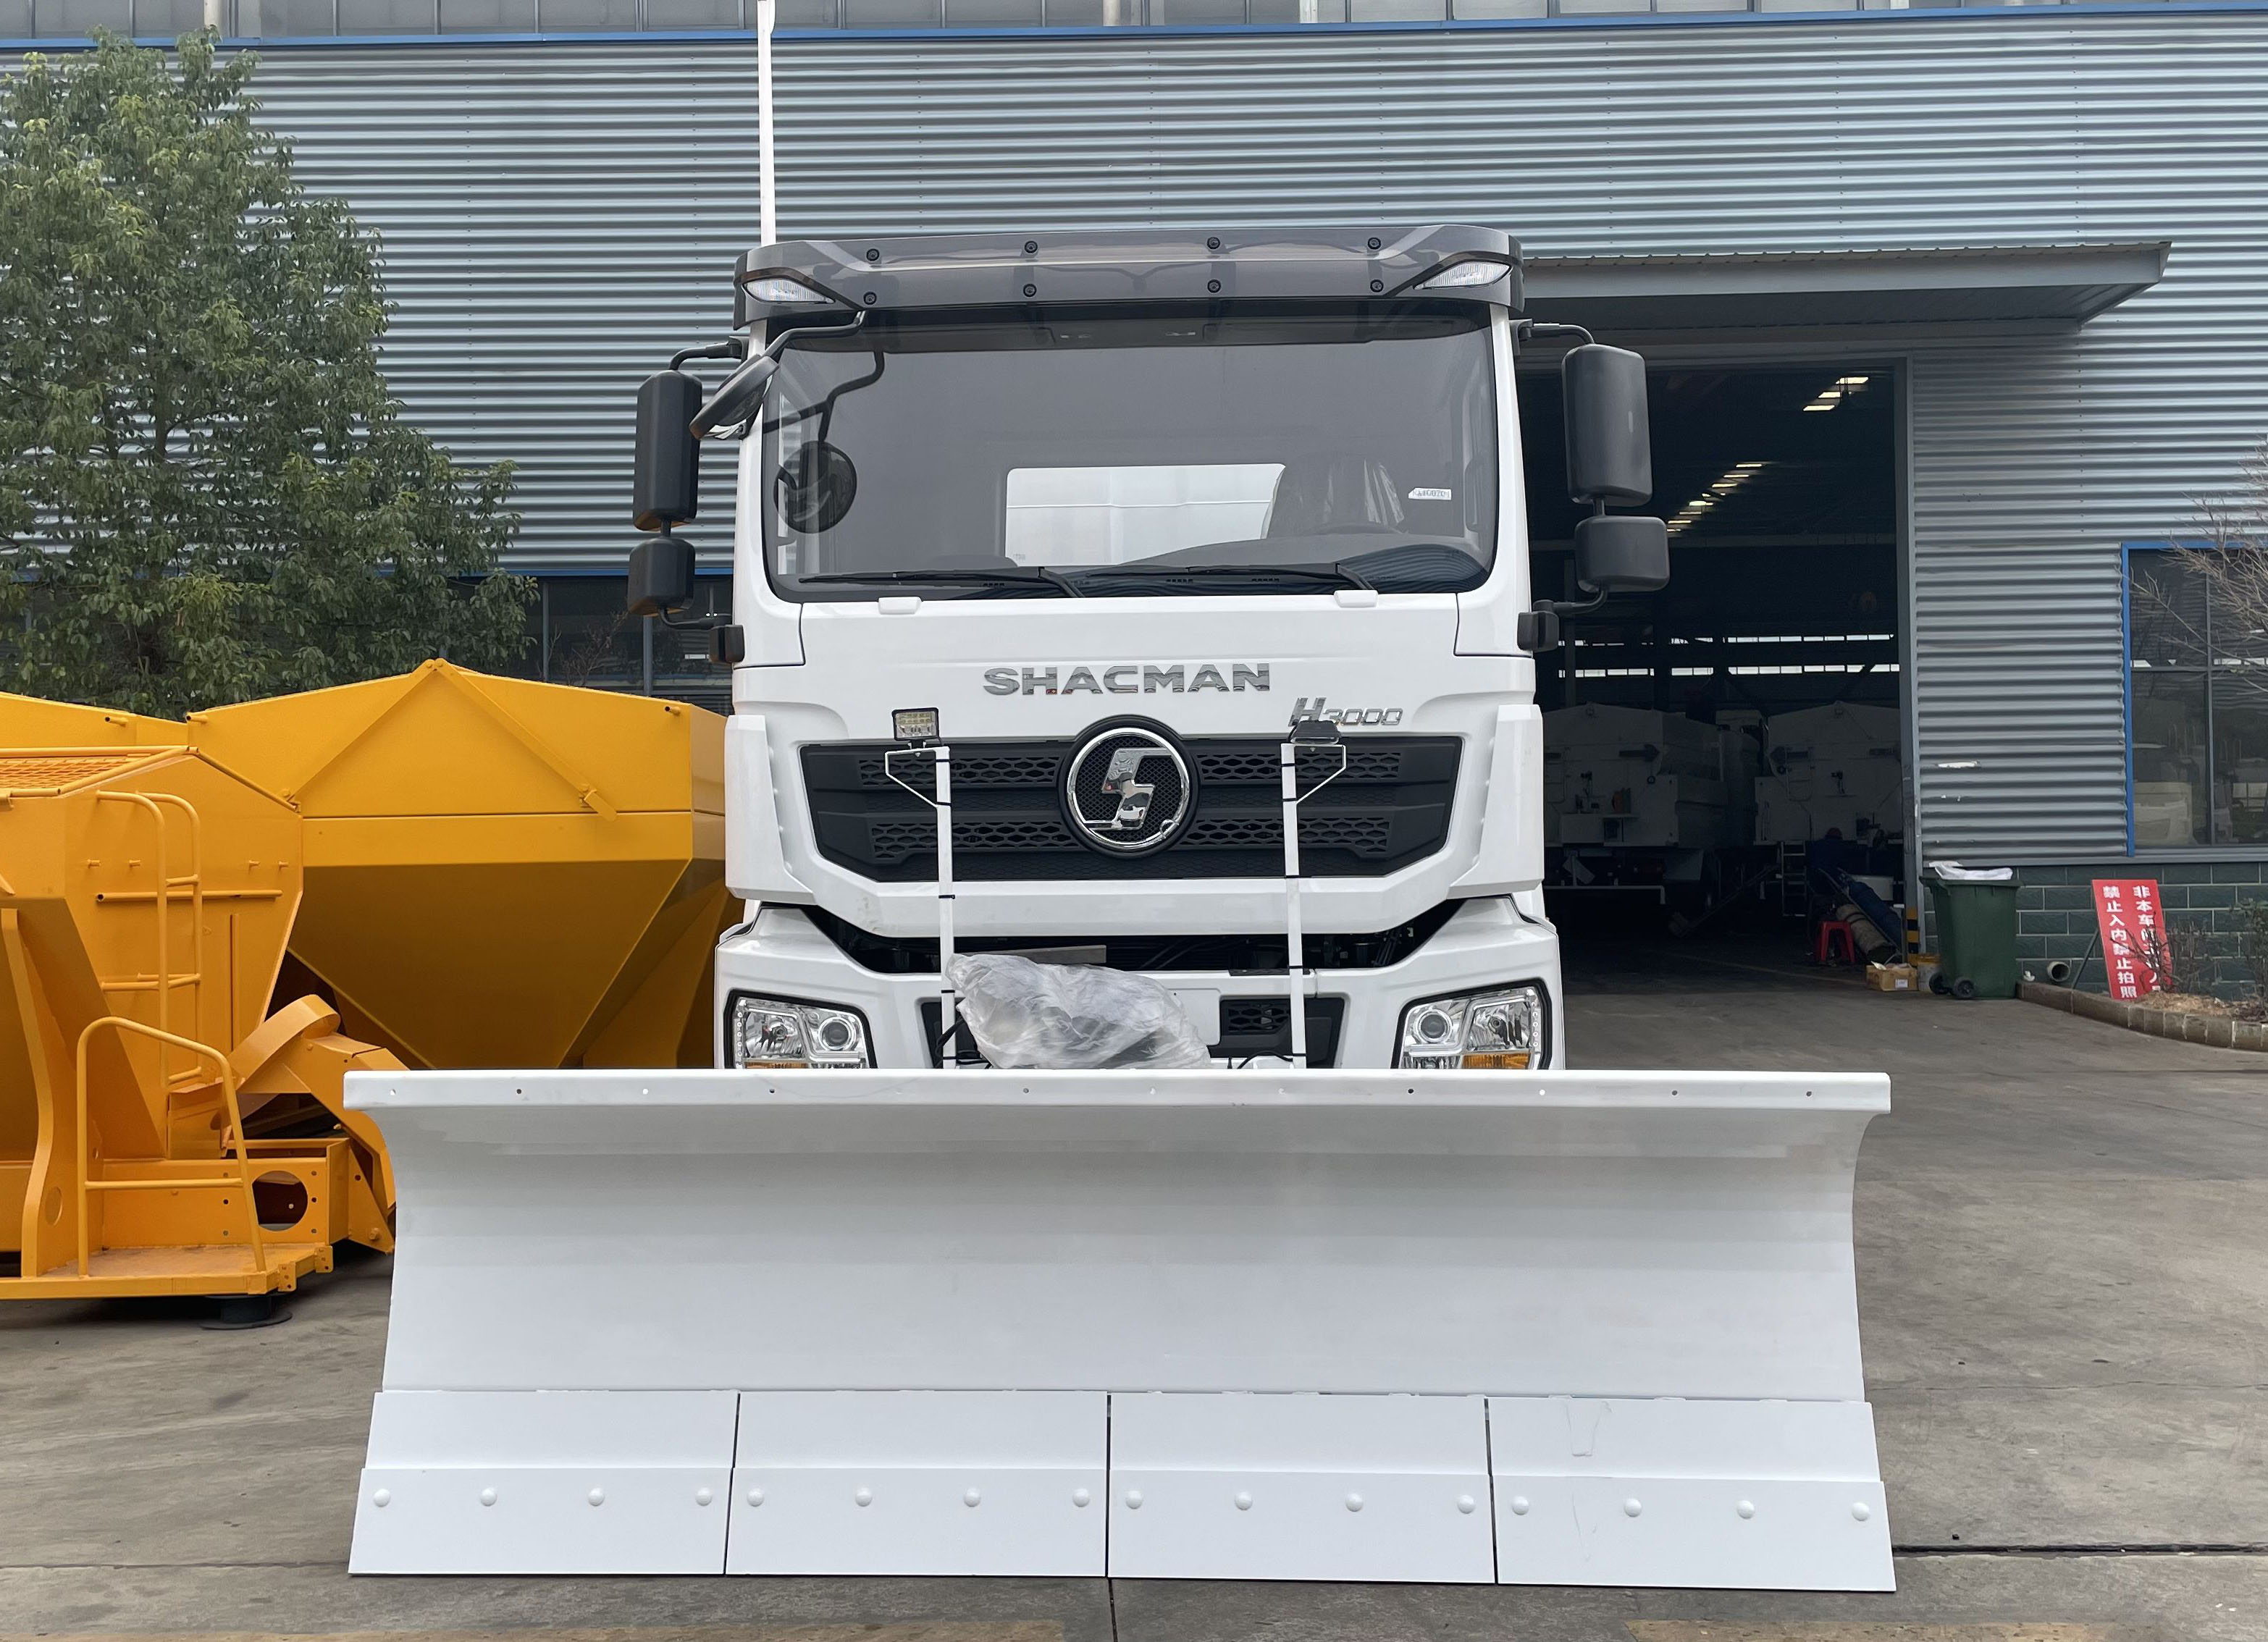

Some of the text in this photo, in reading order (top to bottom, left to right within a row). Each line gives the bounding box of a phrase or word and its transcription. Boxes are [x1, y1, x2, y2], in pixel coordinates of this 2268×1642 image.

[983, 662, 1270, 696] SHACMAN
[1288, 697, 1403, 727] H3000
[2102, 885, 2138, 998] 禁止入内禁止拍照
